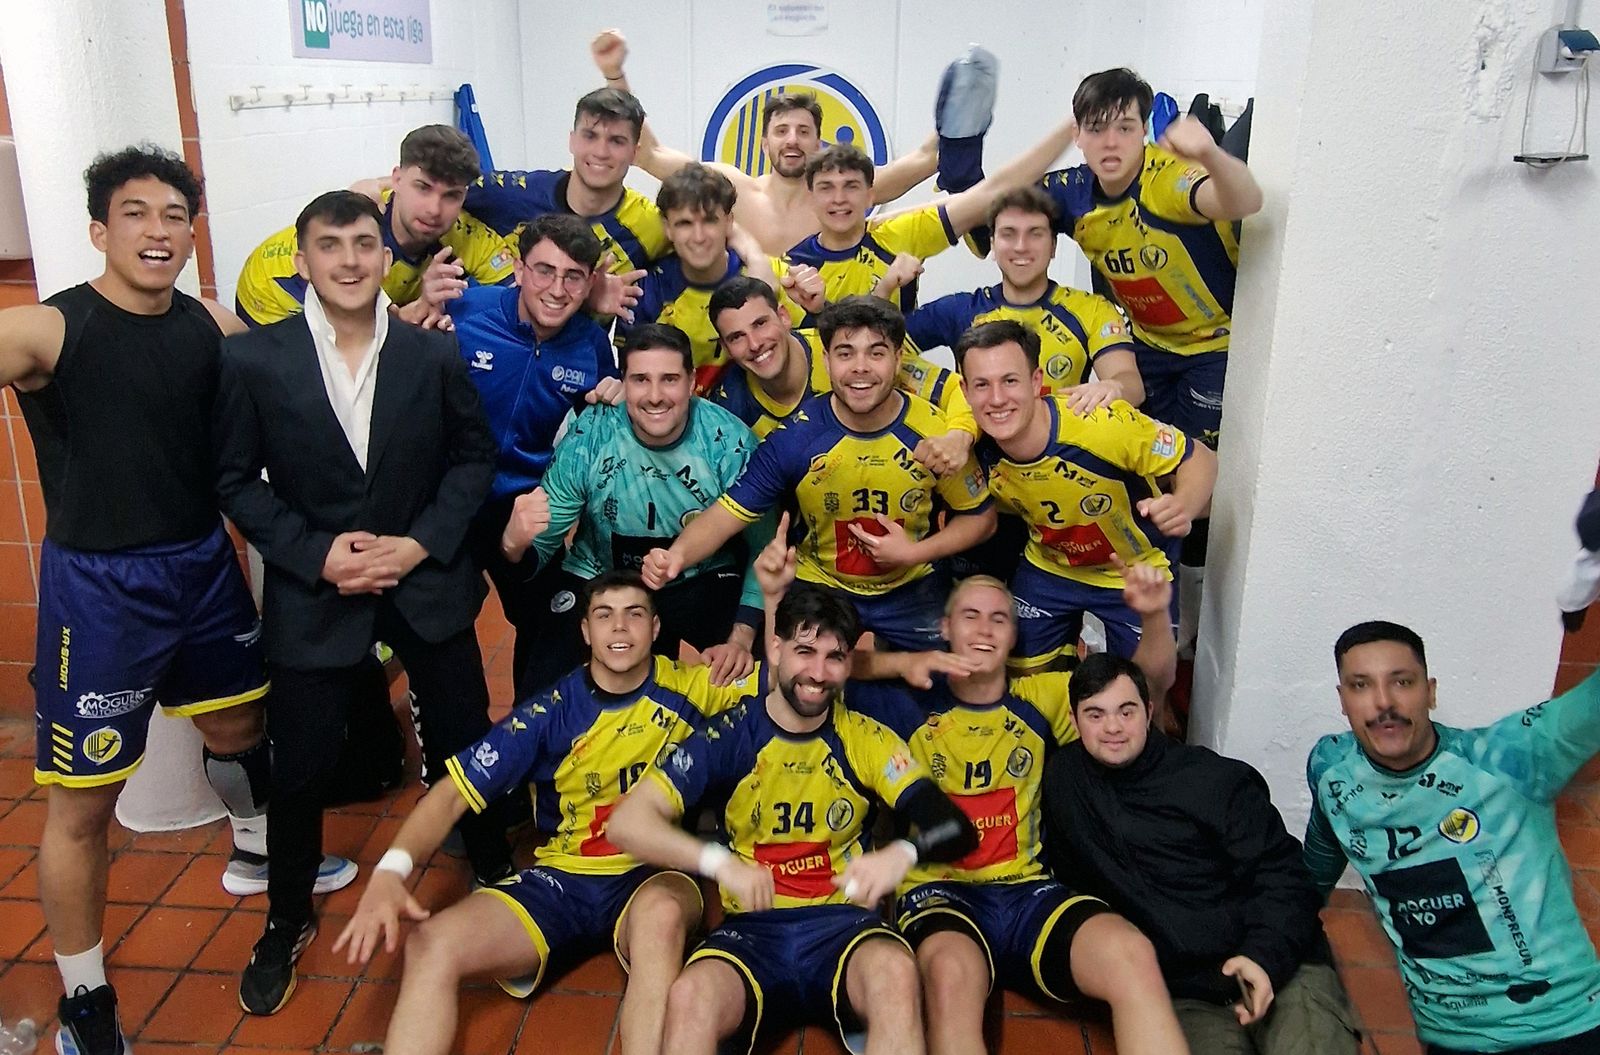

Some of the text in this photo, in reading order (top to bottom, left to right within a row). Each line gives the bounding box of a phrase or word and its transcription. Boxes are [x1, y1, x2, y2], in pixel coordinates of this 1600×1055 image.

[304, 0, 423, 44] NO juega en esta liga
[1104, 247, 1136, 275] 66
[647, 501, 656, 530] 1
[852, 487, 889, 516] 33
[1040, 500, 1065, 524] 2
[964, 759, 992, 790] 19
[772, 802, 816, 835] 34
[973, 815, 1012, 830] GUER
[1385, 825, 1423, 861] 12
